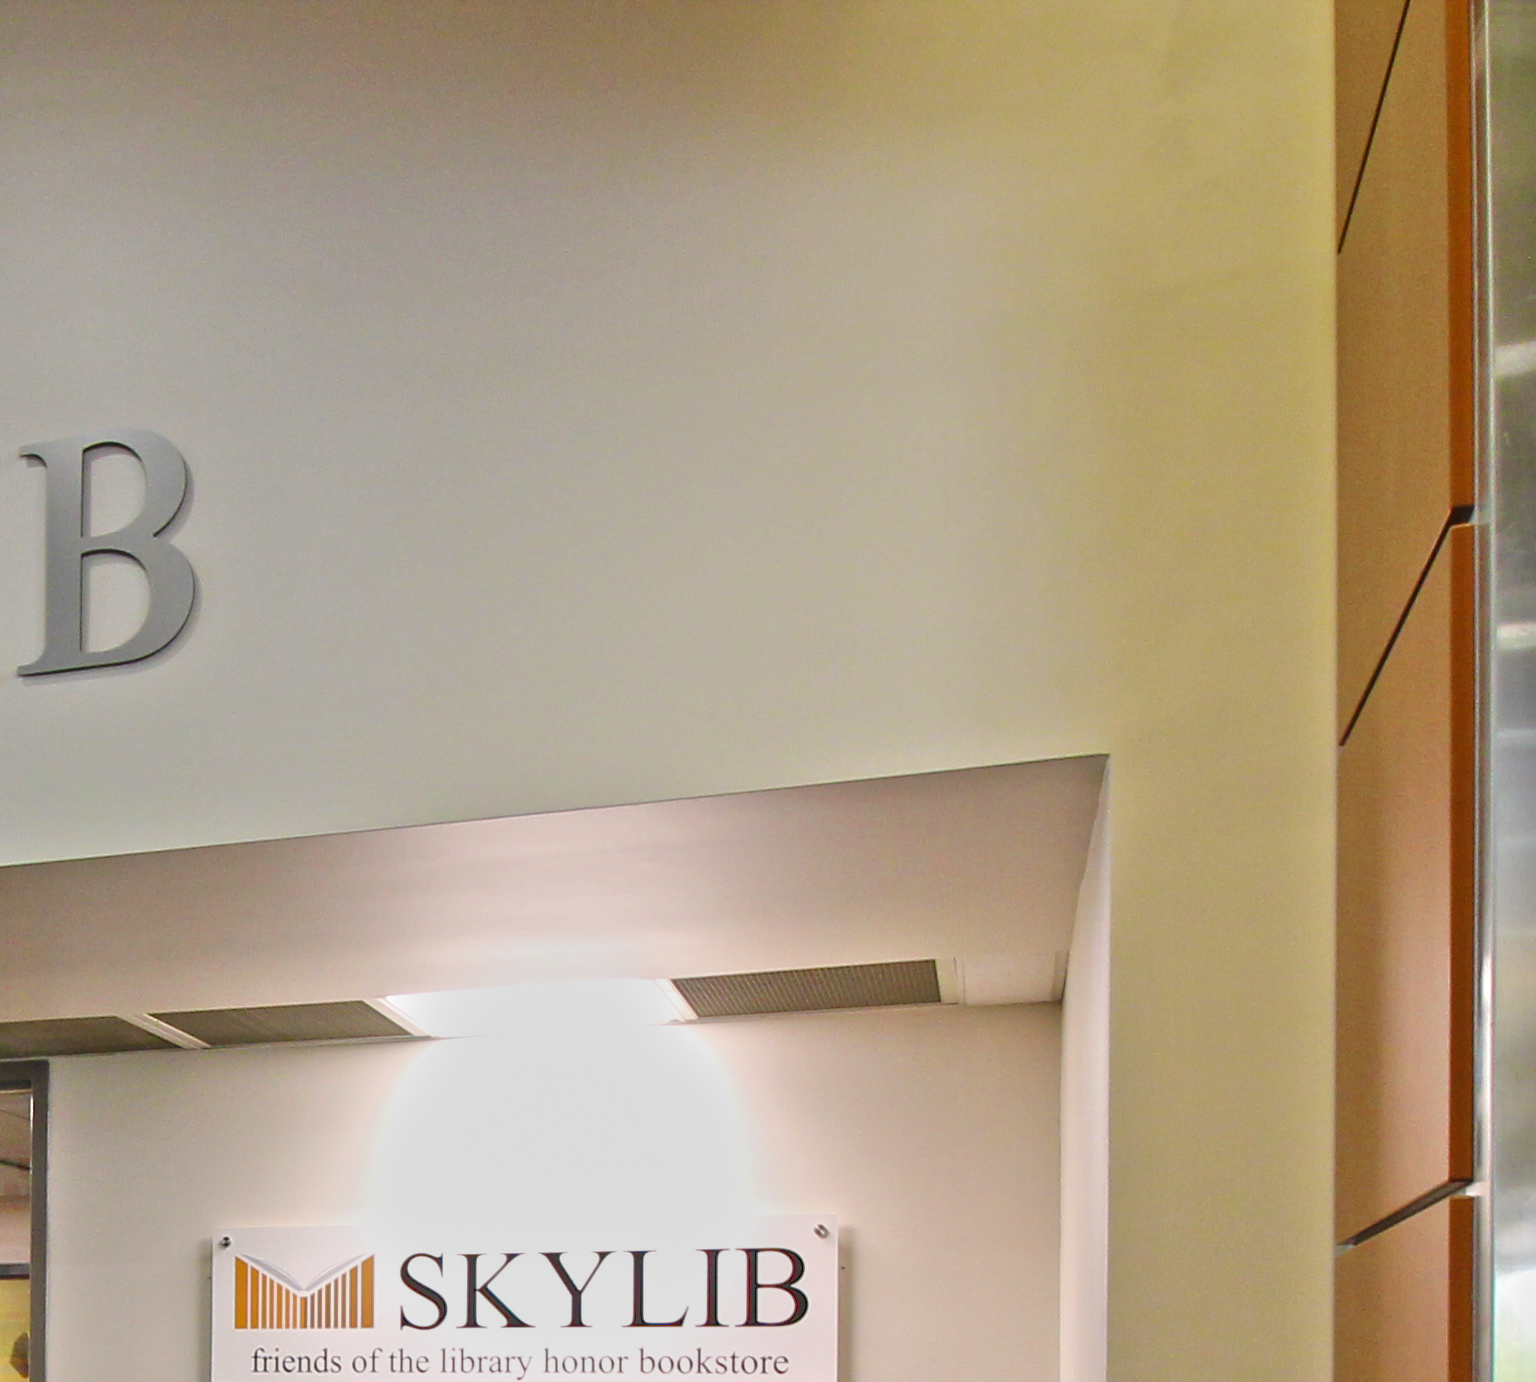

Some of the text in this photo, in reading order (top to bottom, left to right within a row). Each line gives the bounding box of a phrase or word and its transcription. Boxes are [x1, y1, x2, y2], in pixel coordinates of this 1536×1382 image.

[400, 1247, 809, 1330] SKYLIB
[251, 1347, 790, 1381] friends of the library honor bookstore
